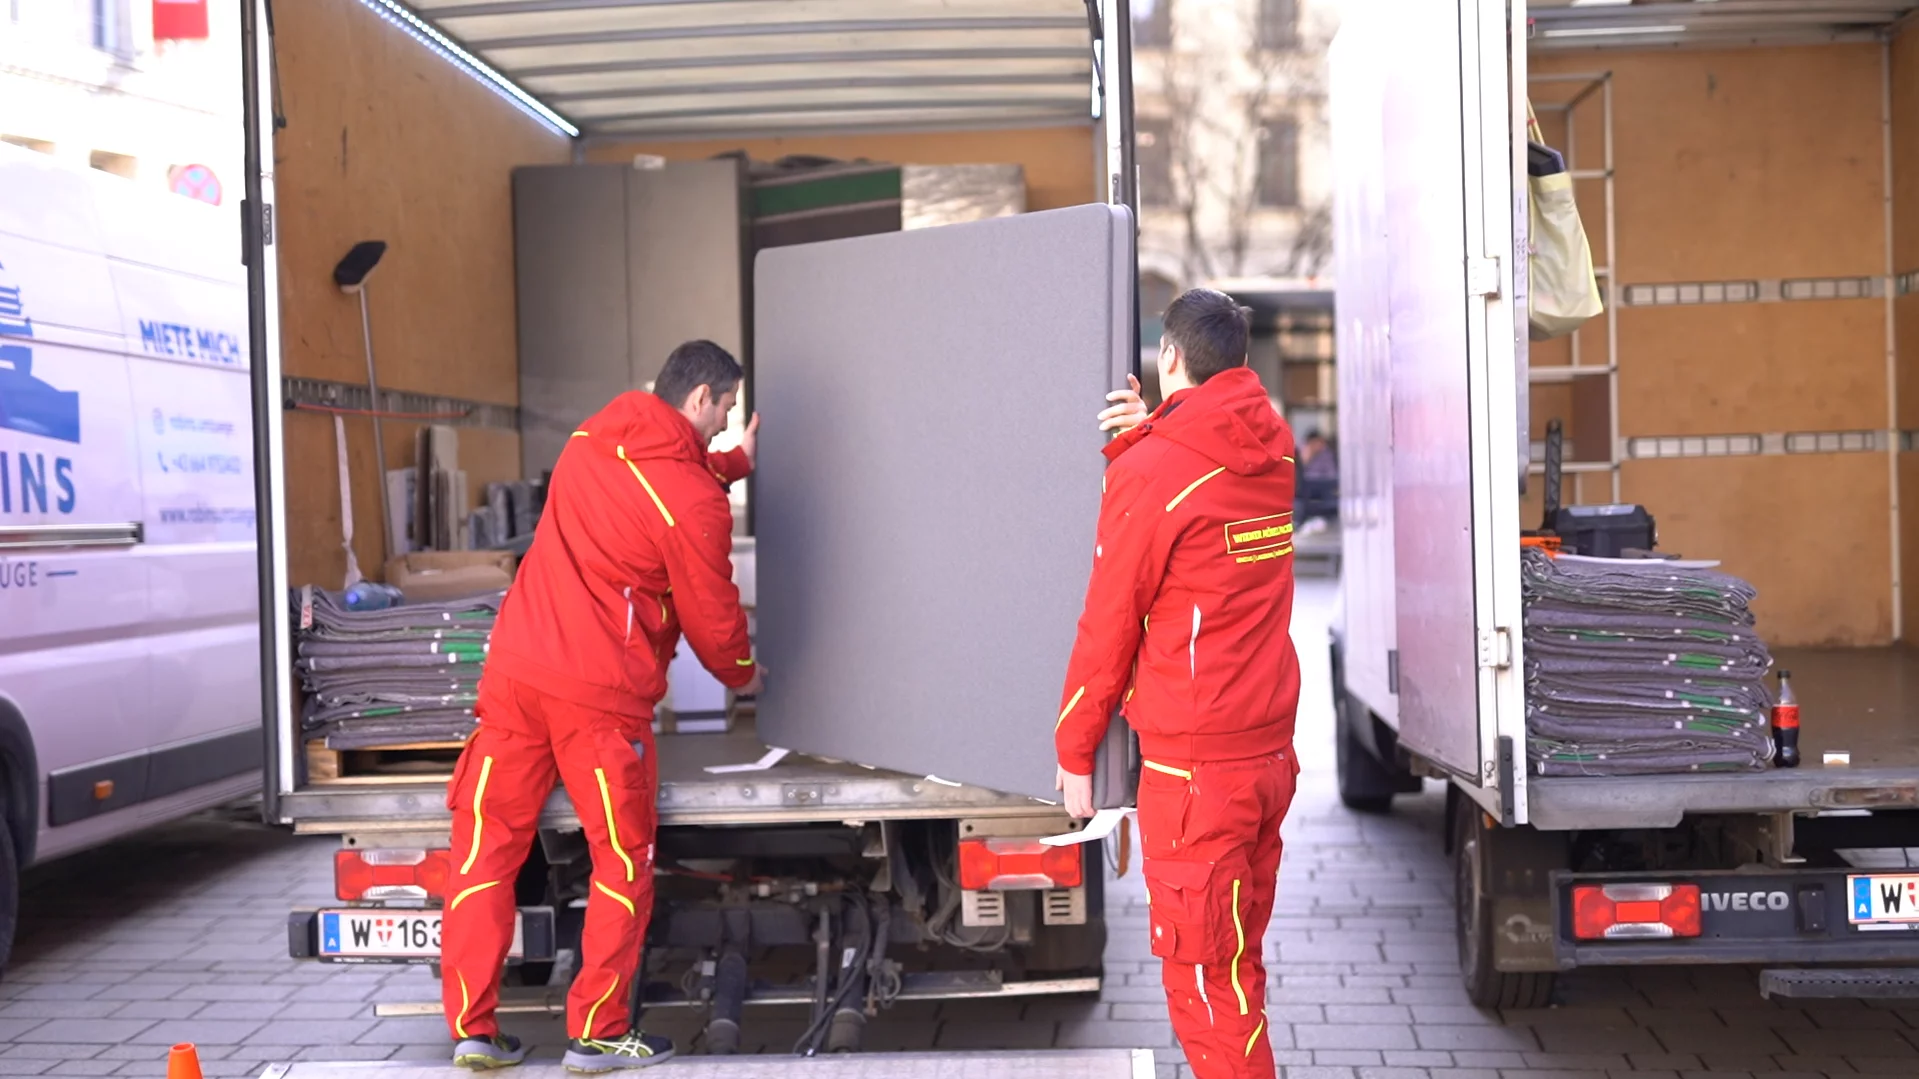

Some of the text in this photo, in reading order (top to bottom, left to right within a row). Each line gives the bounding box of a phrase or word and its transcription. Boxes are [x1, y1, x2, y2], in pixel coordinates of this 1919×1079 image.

[139, 319, 240, 363] MIETE MICH
[0, 451, 76, 514] INS
[1701, 890, 1790, 912] IVECO
[1858, 882, 1903, 914] A W
[327, 938, 337, 948] A
[351, 919, 371, 948] W
